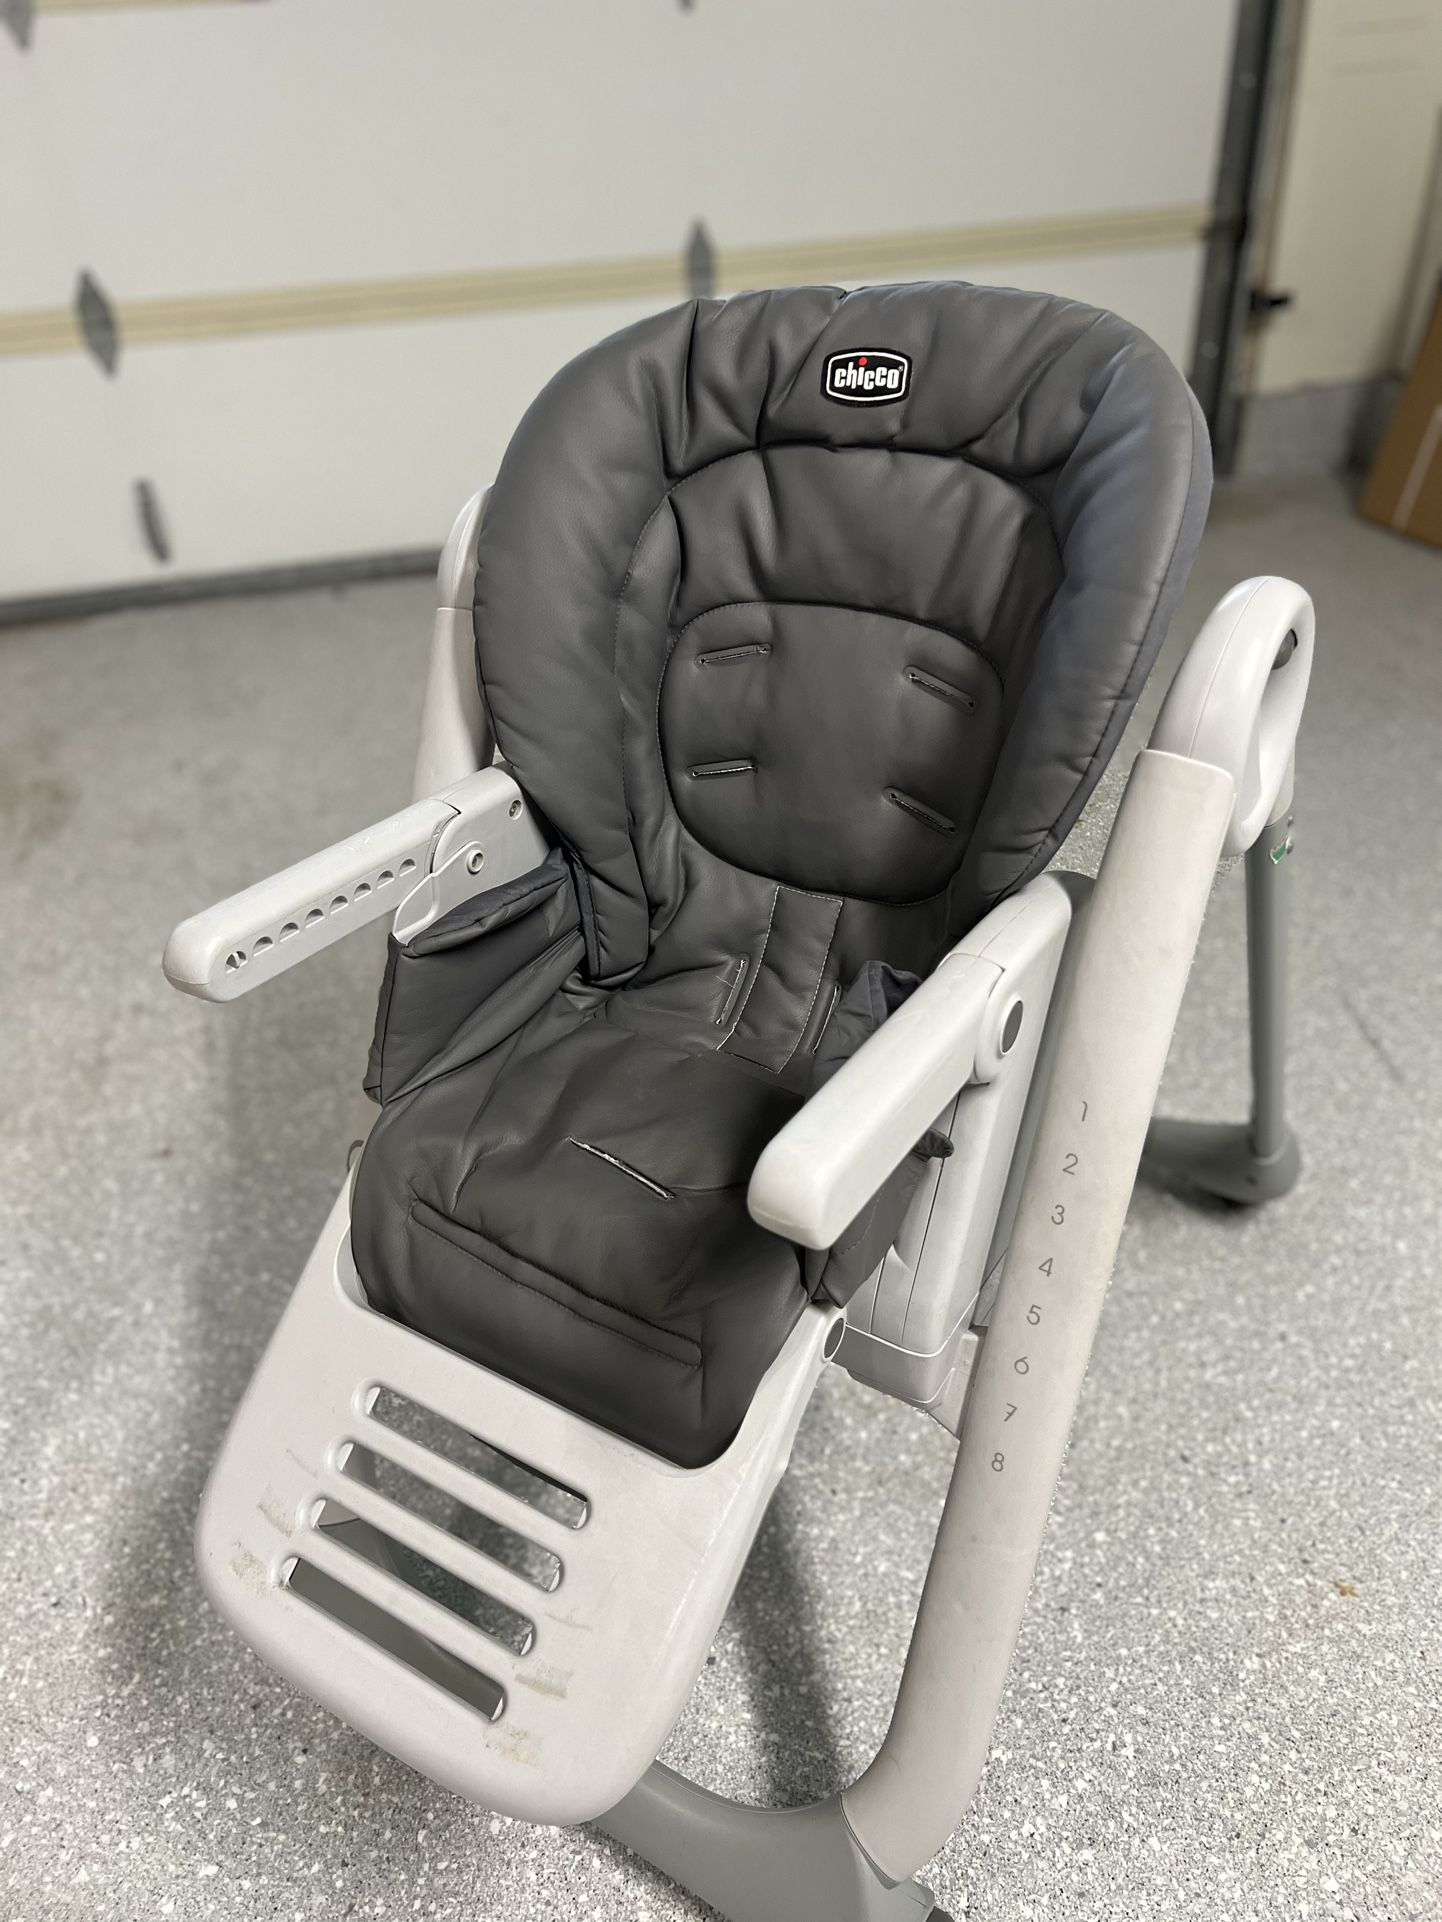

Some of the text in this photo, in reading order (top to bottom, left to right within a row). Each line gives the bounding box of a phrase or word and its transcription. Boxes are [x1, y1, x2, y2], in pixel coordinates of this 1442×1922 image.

[834, 357, 900, 390] chicco
[1062, 1152, 1079, 1175] 2
[1051, 1204, 1066, 1225] 3
[1038, 1257, 1054, 1277] 4
[1026, 1304, 1042, 1326] 5
[1014, 1356, 1030, 1375] 6
[1003, 1402, 1018, 1422] 7
[991, 1452, 1005, 1472] 8
